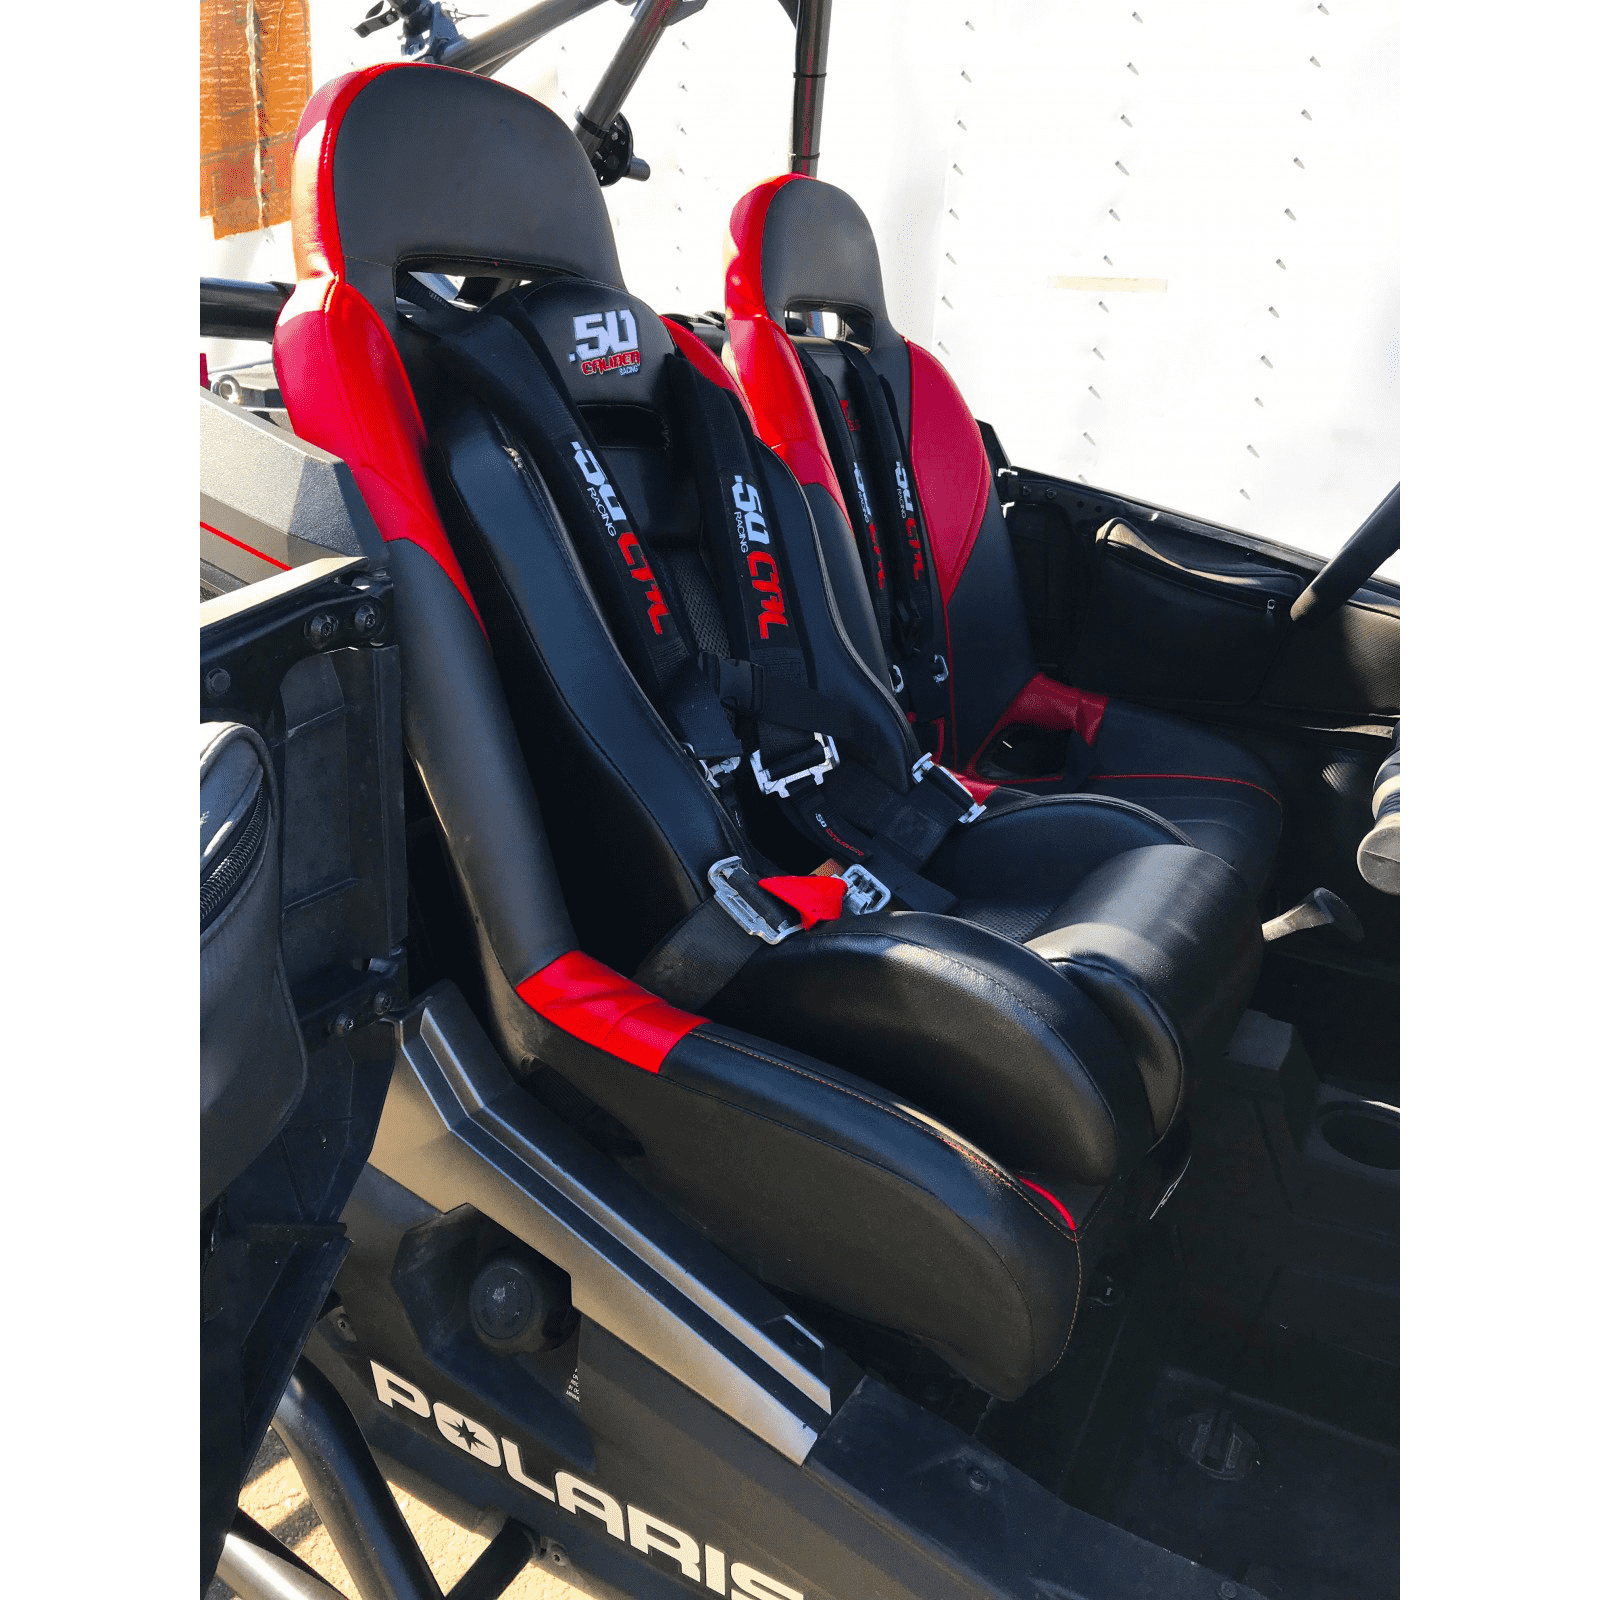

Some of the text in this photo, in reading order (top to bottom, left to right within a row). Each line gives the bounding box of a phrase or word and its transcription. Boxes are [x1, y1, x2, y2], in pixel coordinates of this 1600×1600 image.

[581, 350, 640, 375] CALIBER
[587, 487, 617, 537] RACING
[734, 511, 749, 553] RACING
[747, 551, 788, 639] CAL
